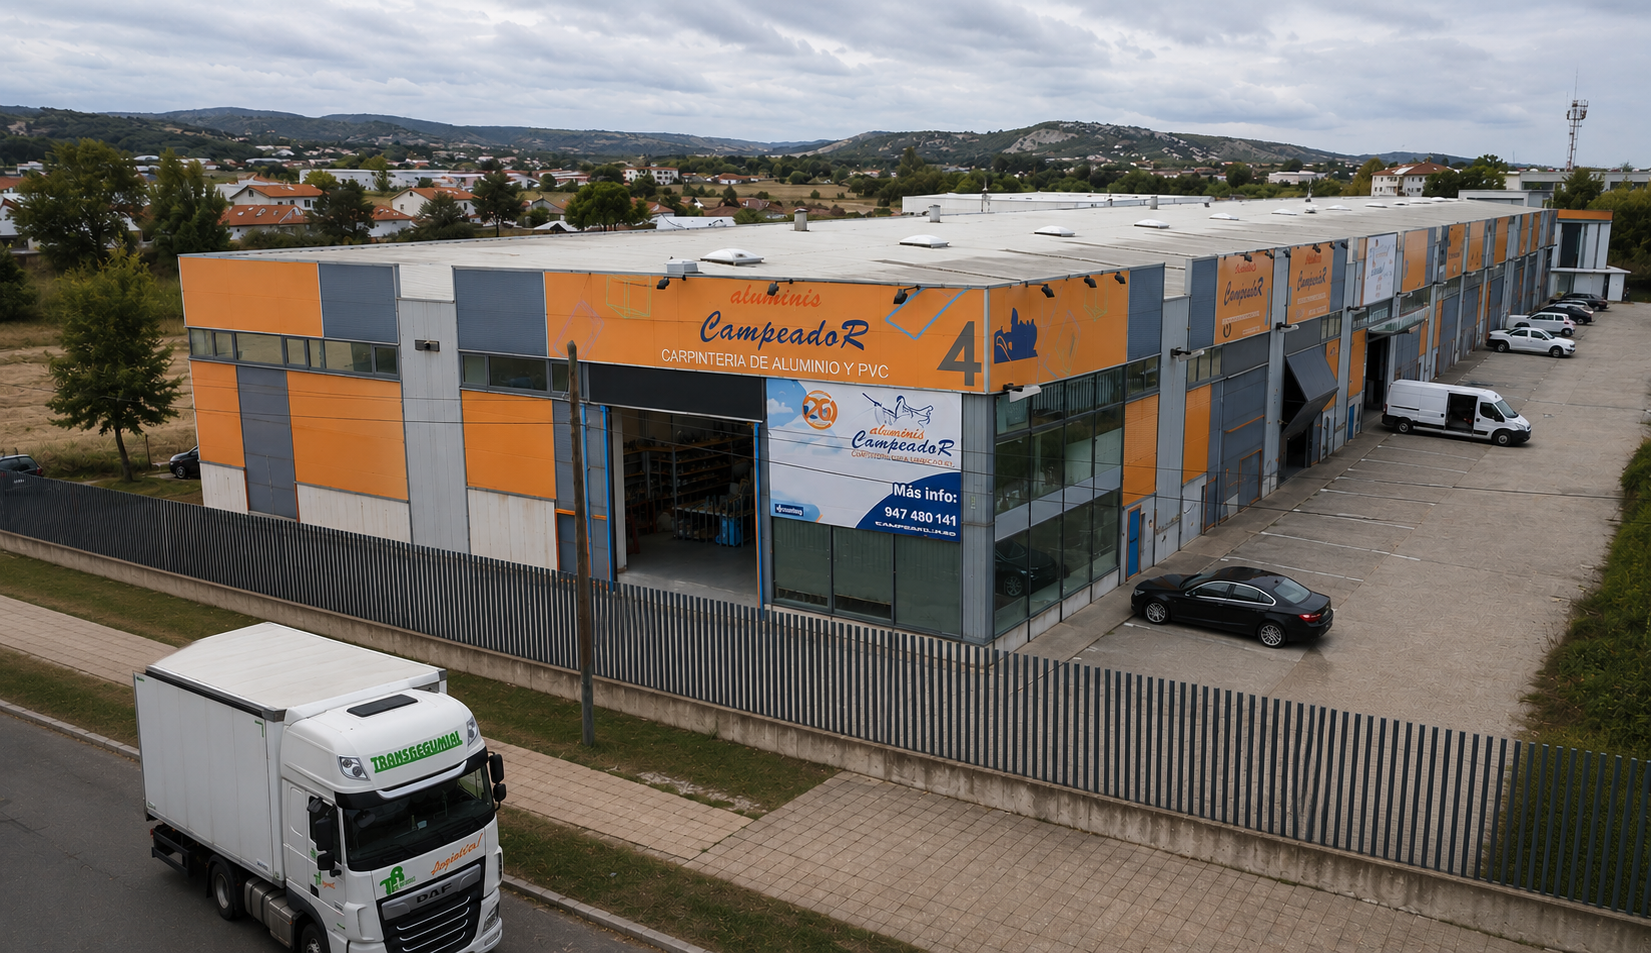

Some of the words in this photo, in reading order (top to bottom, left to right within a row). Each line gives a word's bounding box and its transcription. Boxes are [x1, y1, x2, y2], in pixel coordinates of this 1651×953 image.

[730, 285, 822, 308] aluminis
[661, 348, 746, 368] CARPINTERIA
[750, 355, 768, 370] DE
[772, 356, 840, 375] ALUMINIO
[843, 362, 854, 376] Y
[858, 363, 889, 379] PVC
[937, 321, 982, 387] 4
[893, 484, 922, 499] Más
[925, 487, 958, 503] info:
[884, 506, 907, 520] 947
[910, 510, 934, 523] 480
[935, 513, 957, 527] 141
[417, 882, 453, 903] DAF
